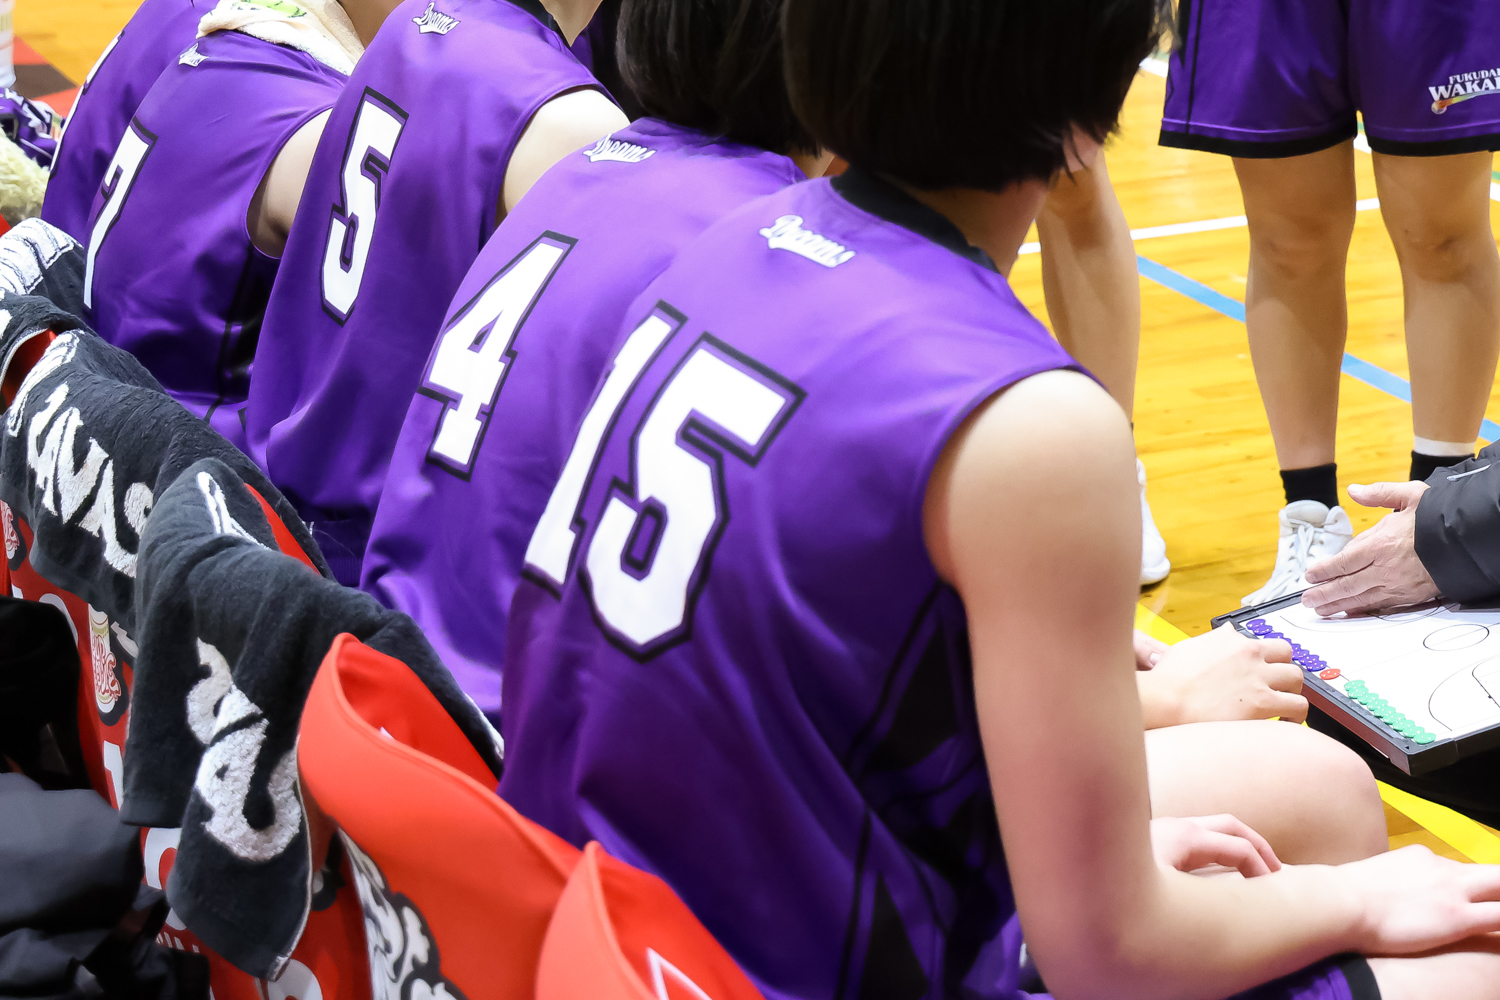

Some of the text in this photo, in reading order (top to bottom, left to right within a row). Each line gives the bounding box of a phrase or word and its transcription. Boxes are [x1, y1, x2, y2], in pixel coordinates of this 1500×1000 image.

[83, 117, 158, 312] 7
[331, 87, 409, 327] 5
[582, 132, 657, 163] Dreams
[417, 231, 578, 481] 4
[522, 301, 805, 662] 15
